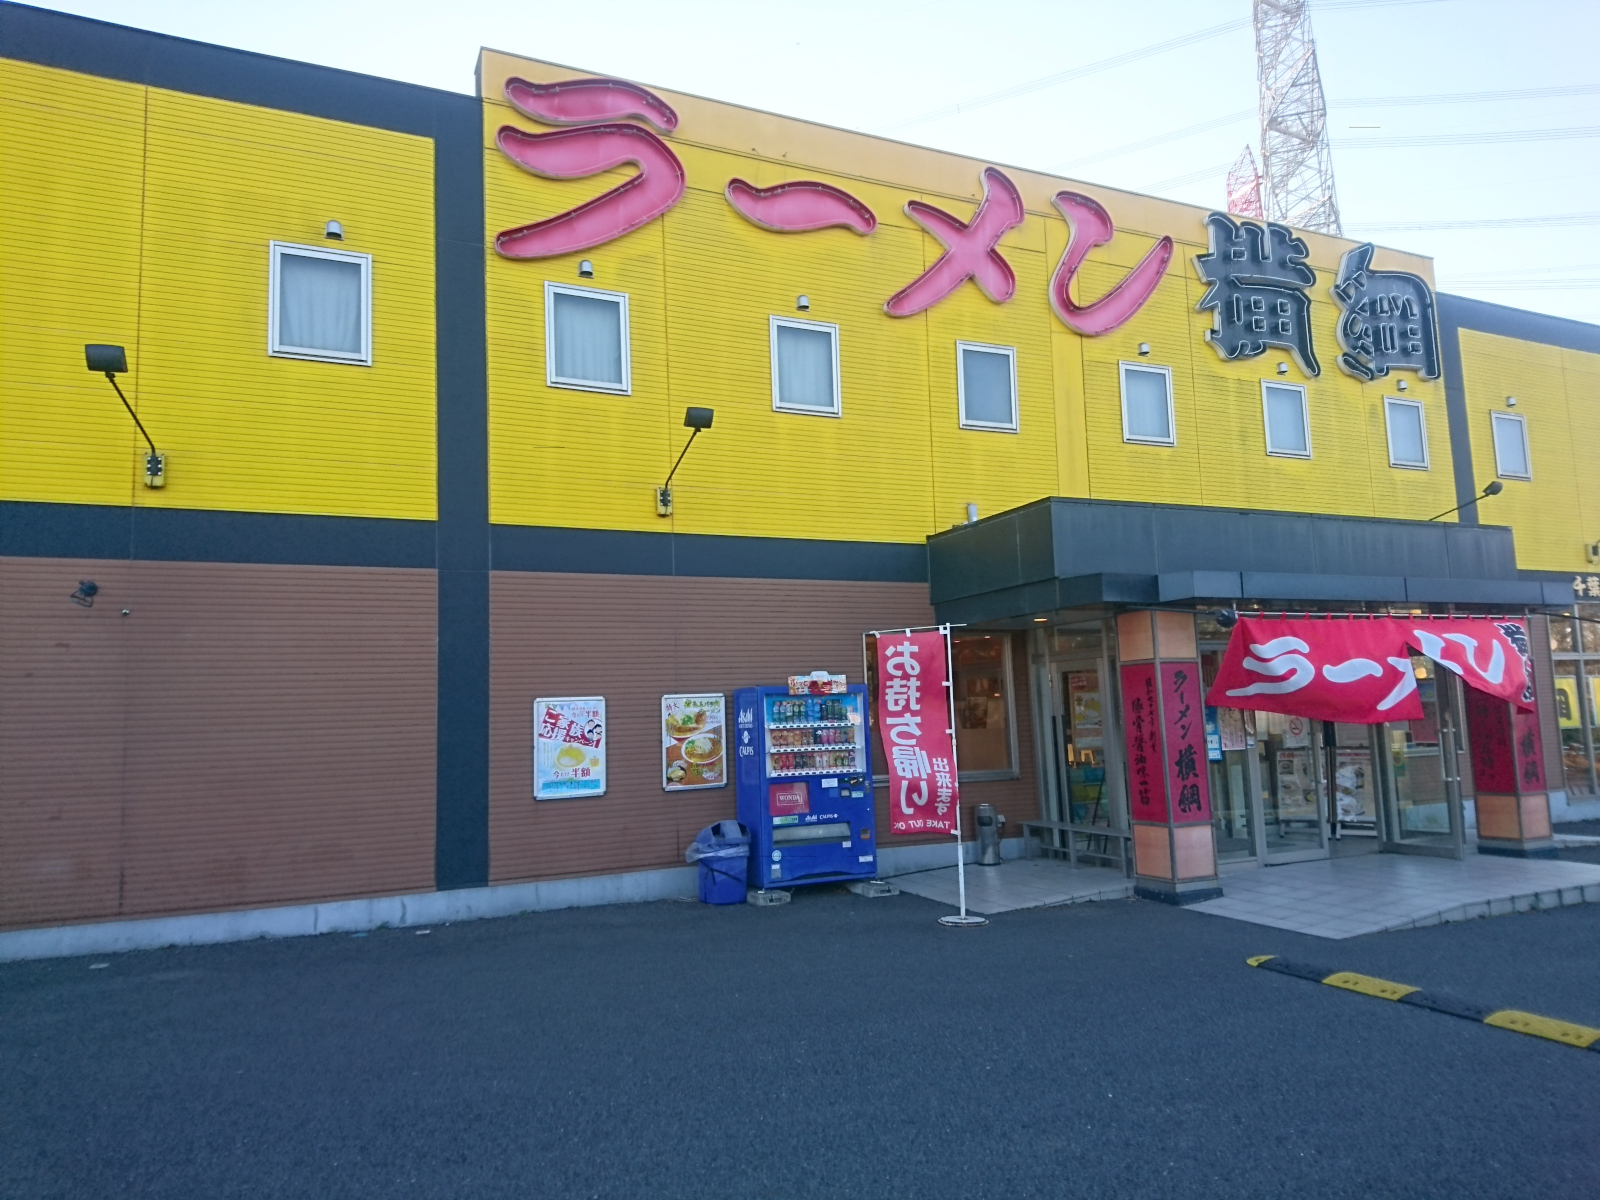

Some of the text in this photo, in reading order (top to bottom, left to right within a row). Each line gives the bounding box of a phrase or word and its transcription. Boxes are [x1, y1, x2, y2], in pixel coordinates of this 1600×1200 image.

[495, 76, 1442, 382] ラーメン 横綱
[1225, 628, 1506, 711] ラーメン
[779, 794, 800, 802] WONDA
[1173, 669, 1203, 814] ラーメン 横綱
